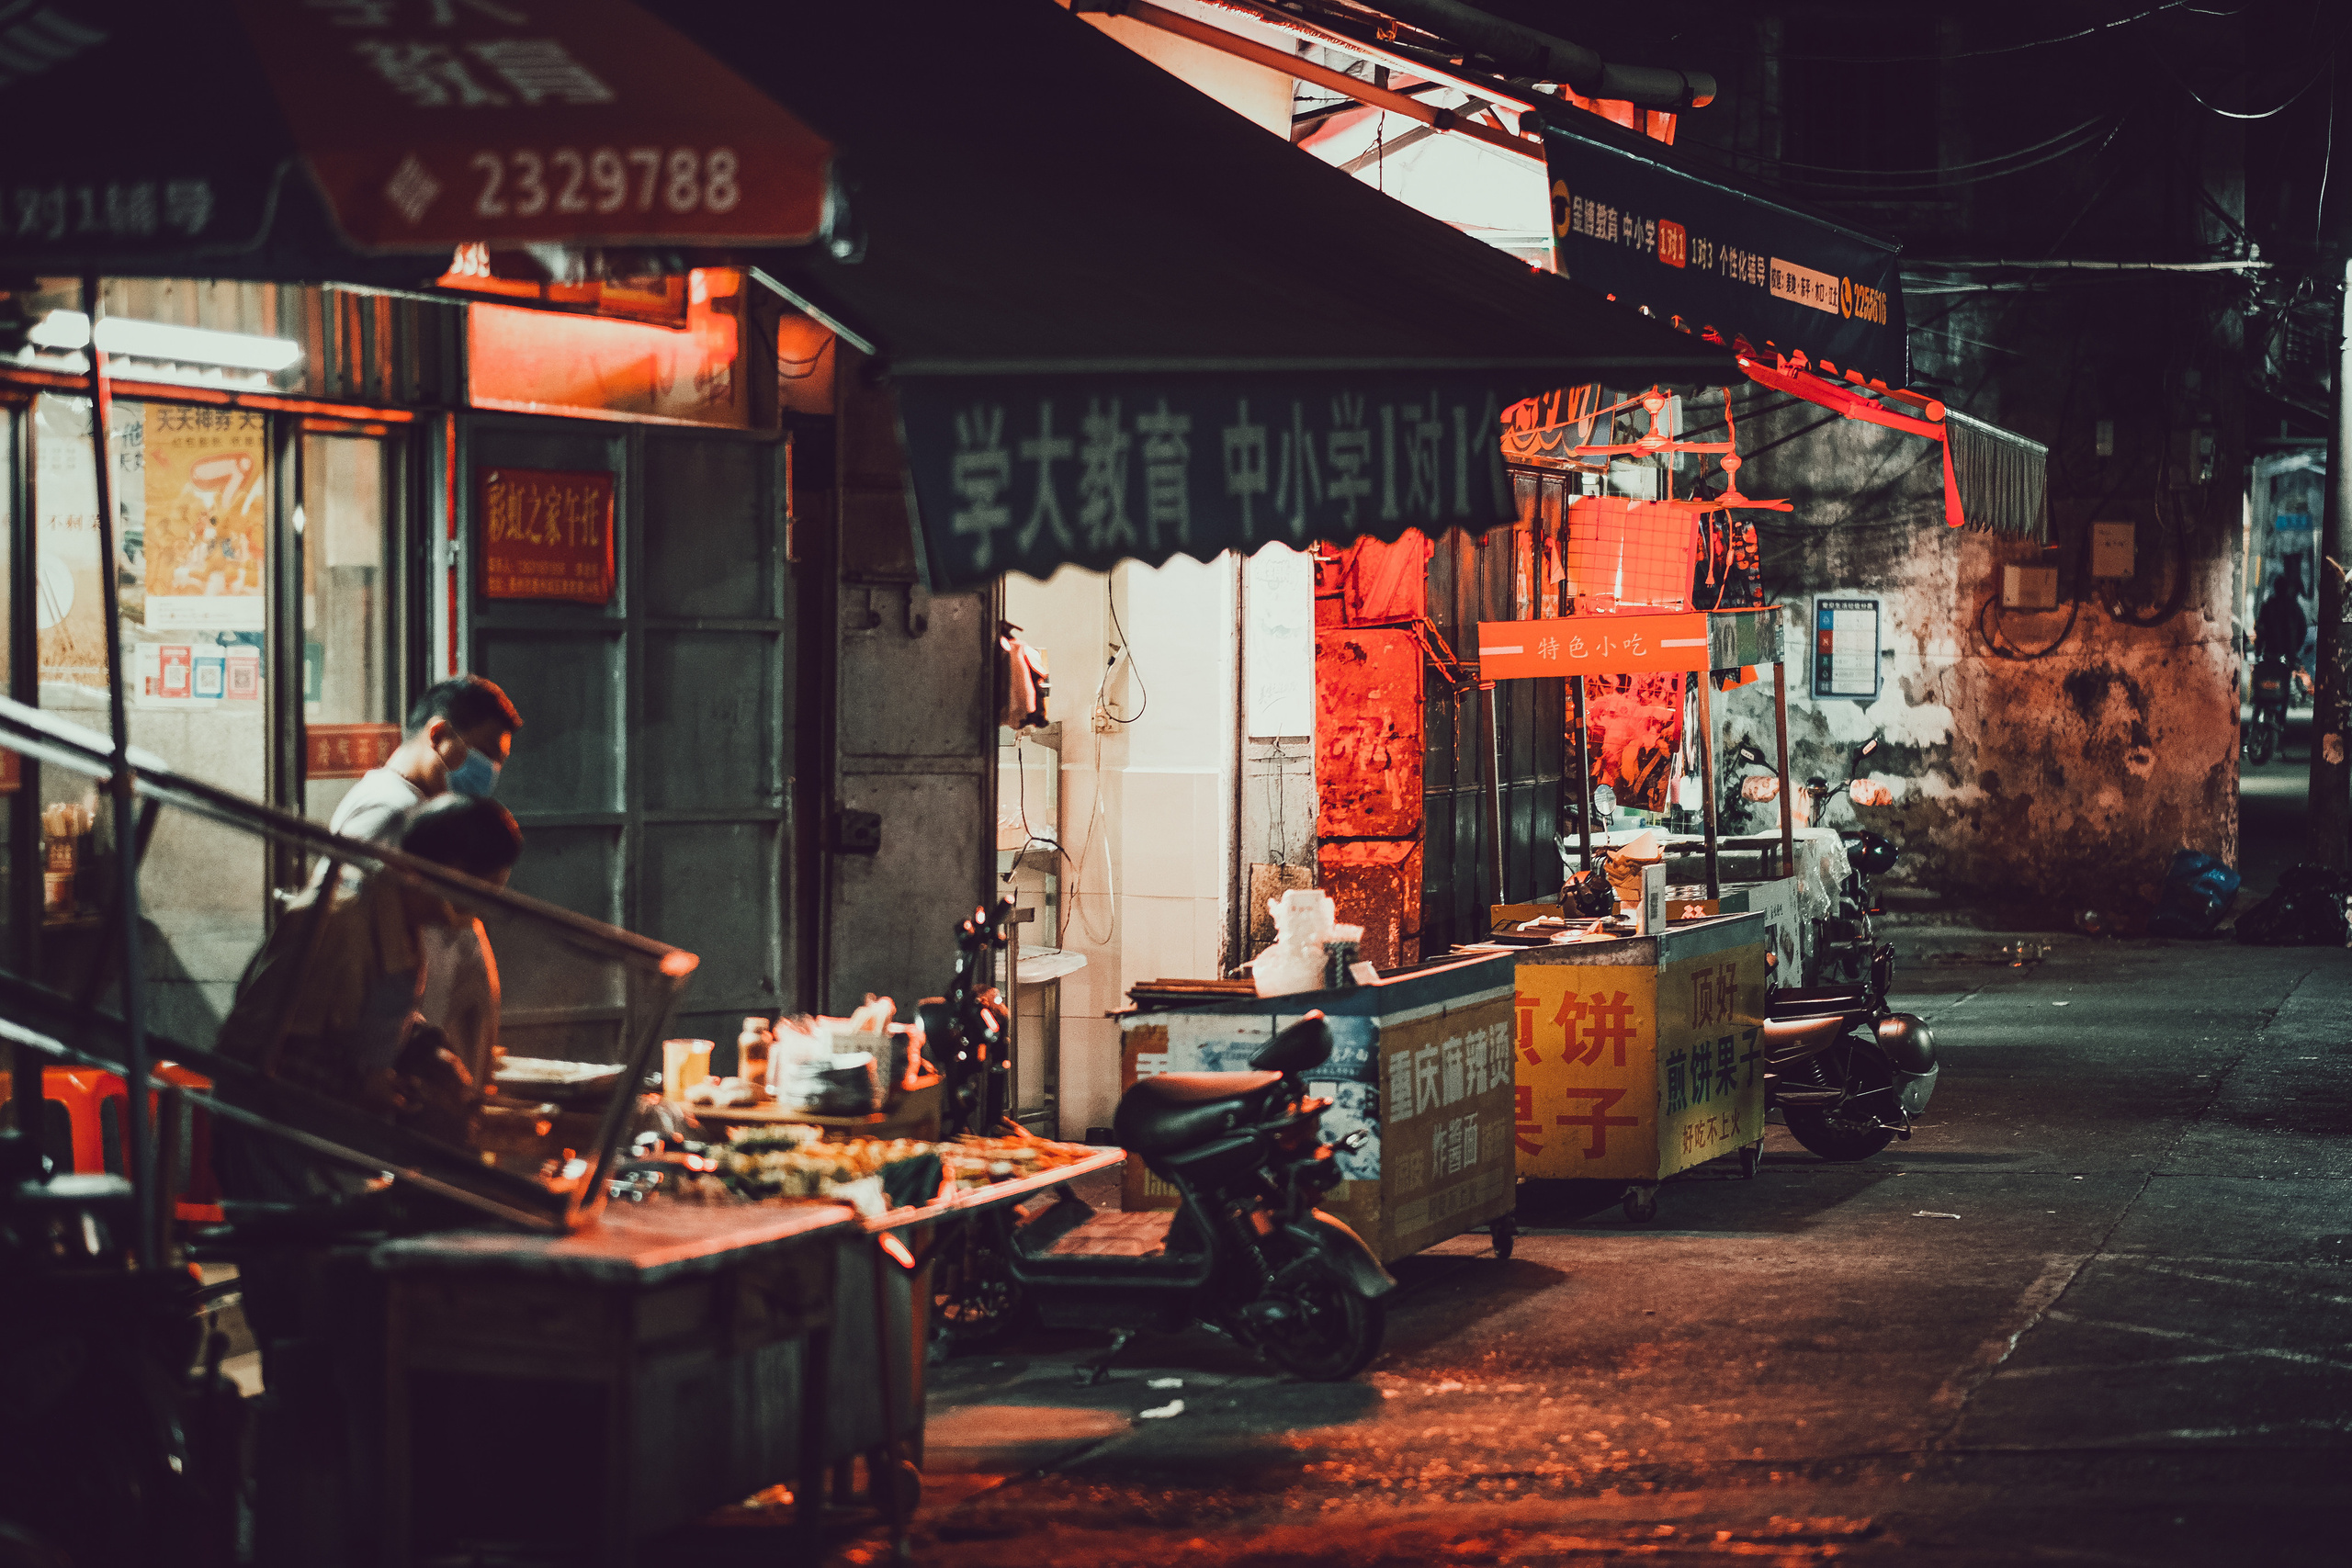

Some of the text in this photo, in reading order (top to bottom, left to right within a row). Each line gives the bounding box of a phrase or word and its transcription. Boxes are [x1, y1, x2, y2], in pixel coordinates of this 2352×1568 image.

[473, 147, 739, 218] 2329788
[1623, 211, 1655, 253] 中小学
[1659, 227, 1684, 261] 1对1
[1691, 236, 1713, 270] 1对3
[1719, 245, 1765, 287] 个性化辅导
[952, 398, 1192, 570] 学大教育
[1537, 633, 1647, 660] 特色小吃
[1690, 964, 1737, 1030] 顶好
[1387, 1021, 1511, 1124] 重庆麻辣烫
[1665, 1032, 1761, 1112] 煎饼果子
[1681, 1112, 1741, 1155] 好吃不上火
